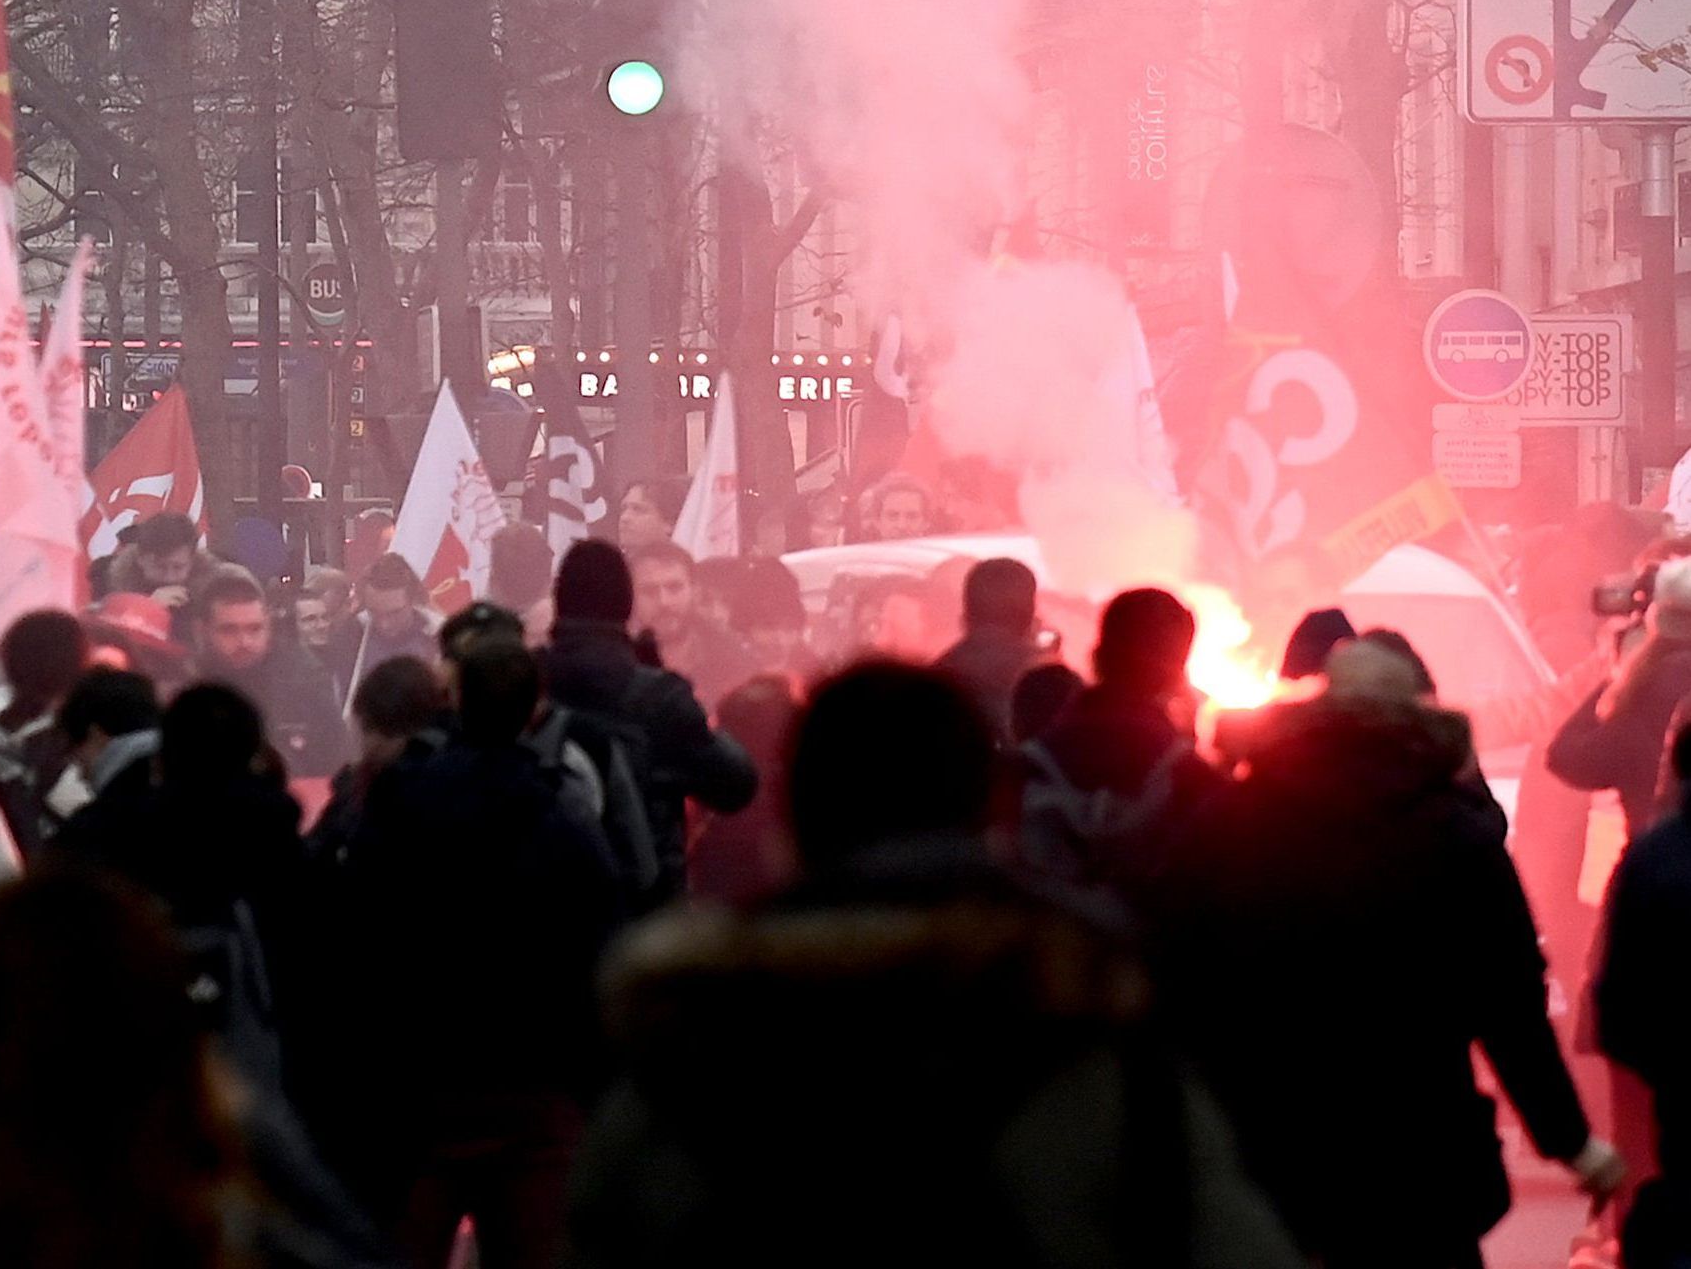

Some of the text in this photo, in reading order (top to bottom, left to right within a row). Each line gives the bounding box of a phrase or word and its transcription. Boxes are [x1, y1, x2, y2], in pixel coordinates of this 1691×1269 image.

[1536, 333, 1610, 353] Y-TOP
[1533, 351, 1610, 371] Y-TOP
[579, 373, 618, 396] BA
[1525, 369, 1611, 389] PY-TOP
[1505, 387, 1611, 407] OPY-TOP
